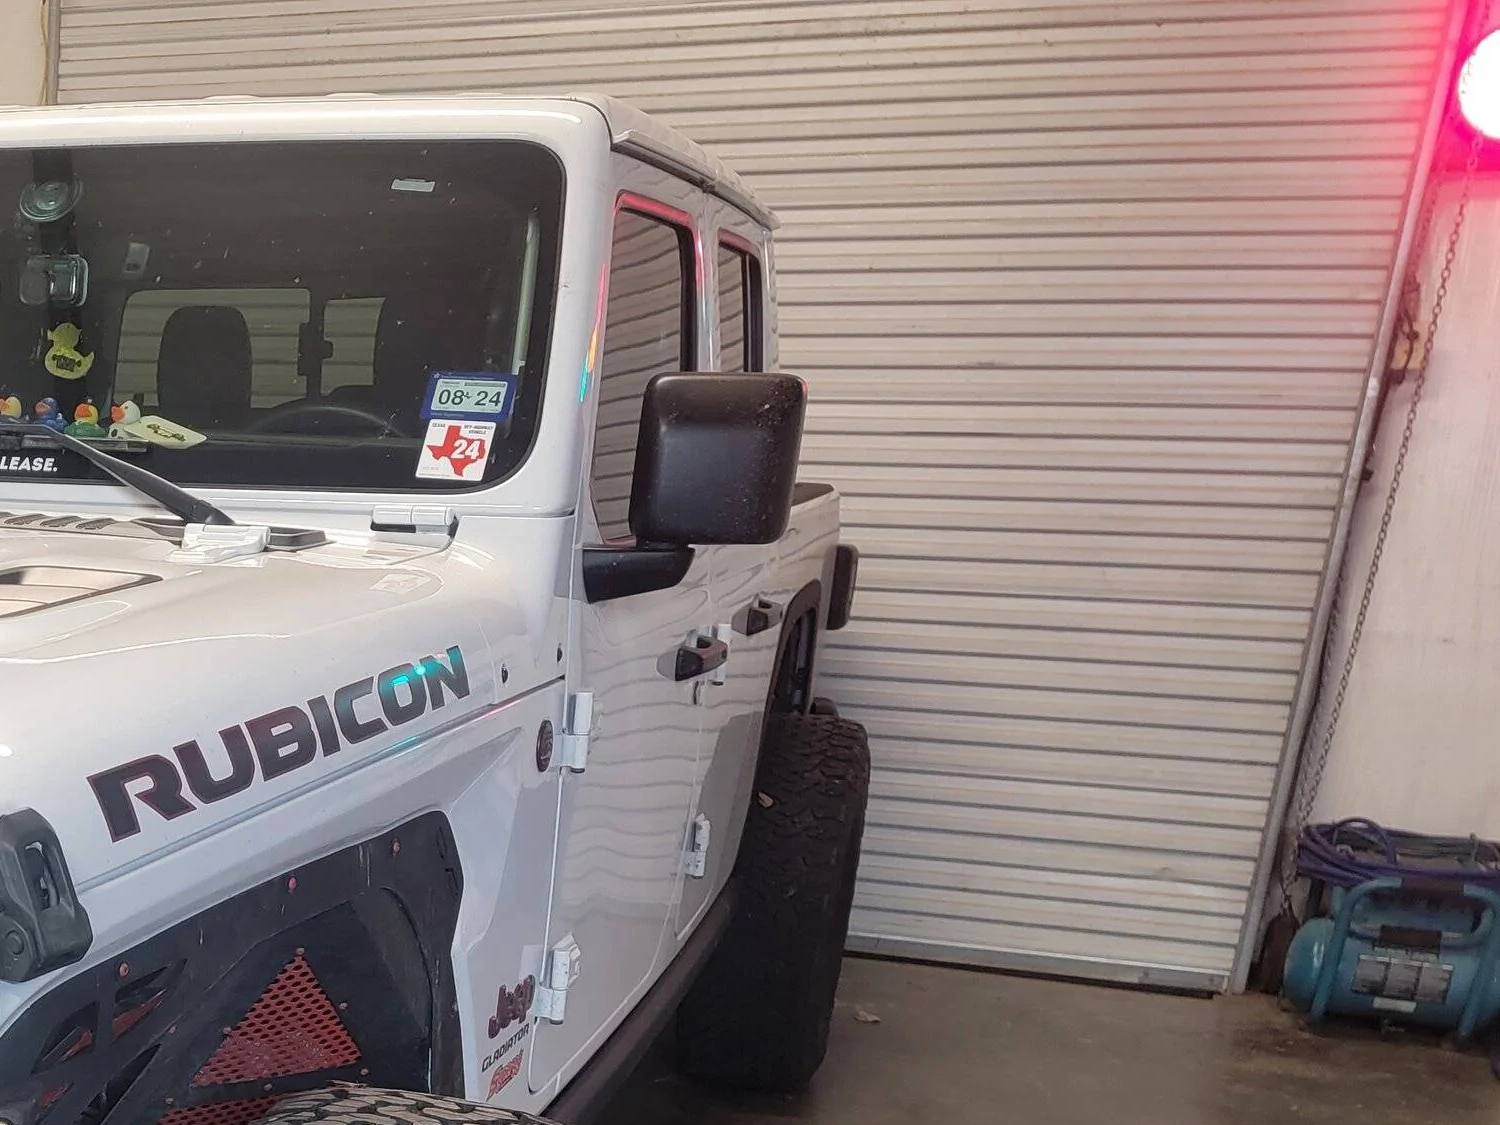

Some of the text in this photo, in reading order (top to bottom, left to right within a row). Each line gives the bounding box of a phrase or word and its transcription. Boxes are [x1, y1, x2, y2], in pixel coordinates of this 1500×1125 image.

[438, 389, 502, 407] 08 24
[450, 438, 481, 460] 24
[86, 645, 471, 843] RUBICON
[488, 974, 536, 1039] Jeep
[481, 1022, 530, 1073] GLADIATOR
